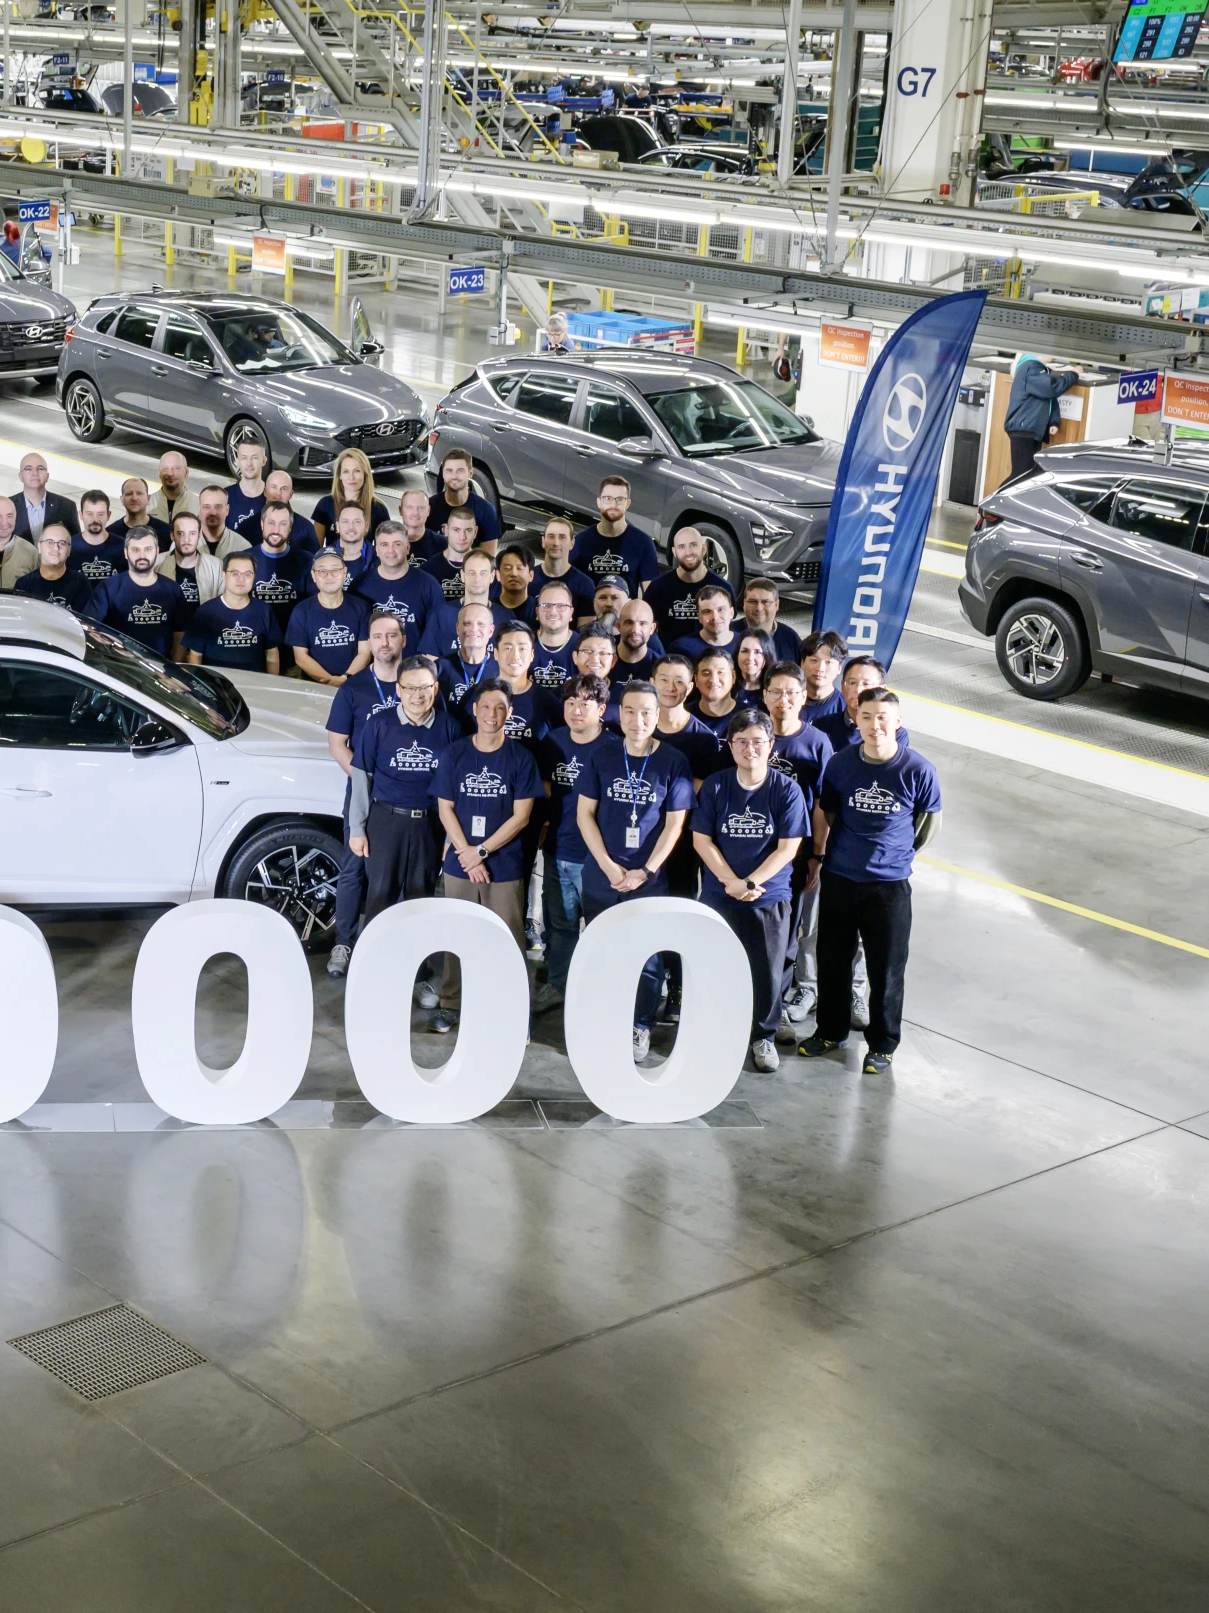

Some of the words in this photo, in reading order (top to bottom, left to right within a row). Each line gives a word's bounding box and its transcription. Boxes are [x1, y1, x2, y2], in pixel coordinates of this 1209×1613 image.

[897, 66, 937, 97] G7
[19, 206, 50, 219] OK-22
[450, 273, 484, 289] OK-23
[1119, 378, 1157, 399] OK-24
[1174, 380, 1185, 389] QC
[846, 463, 908, 658] HYUNDAI
